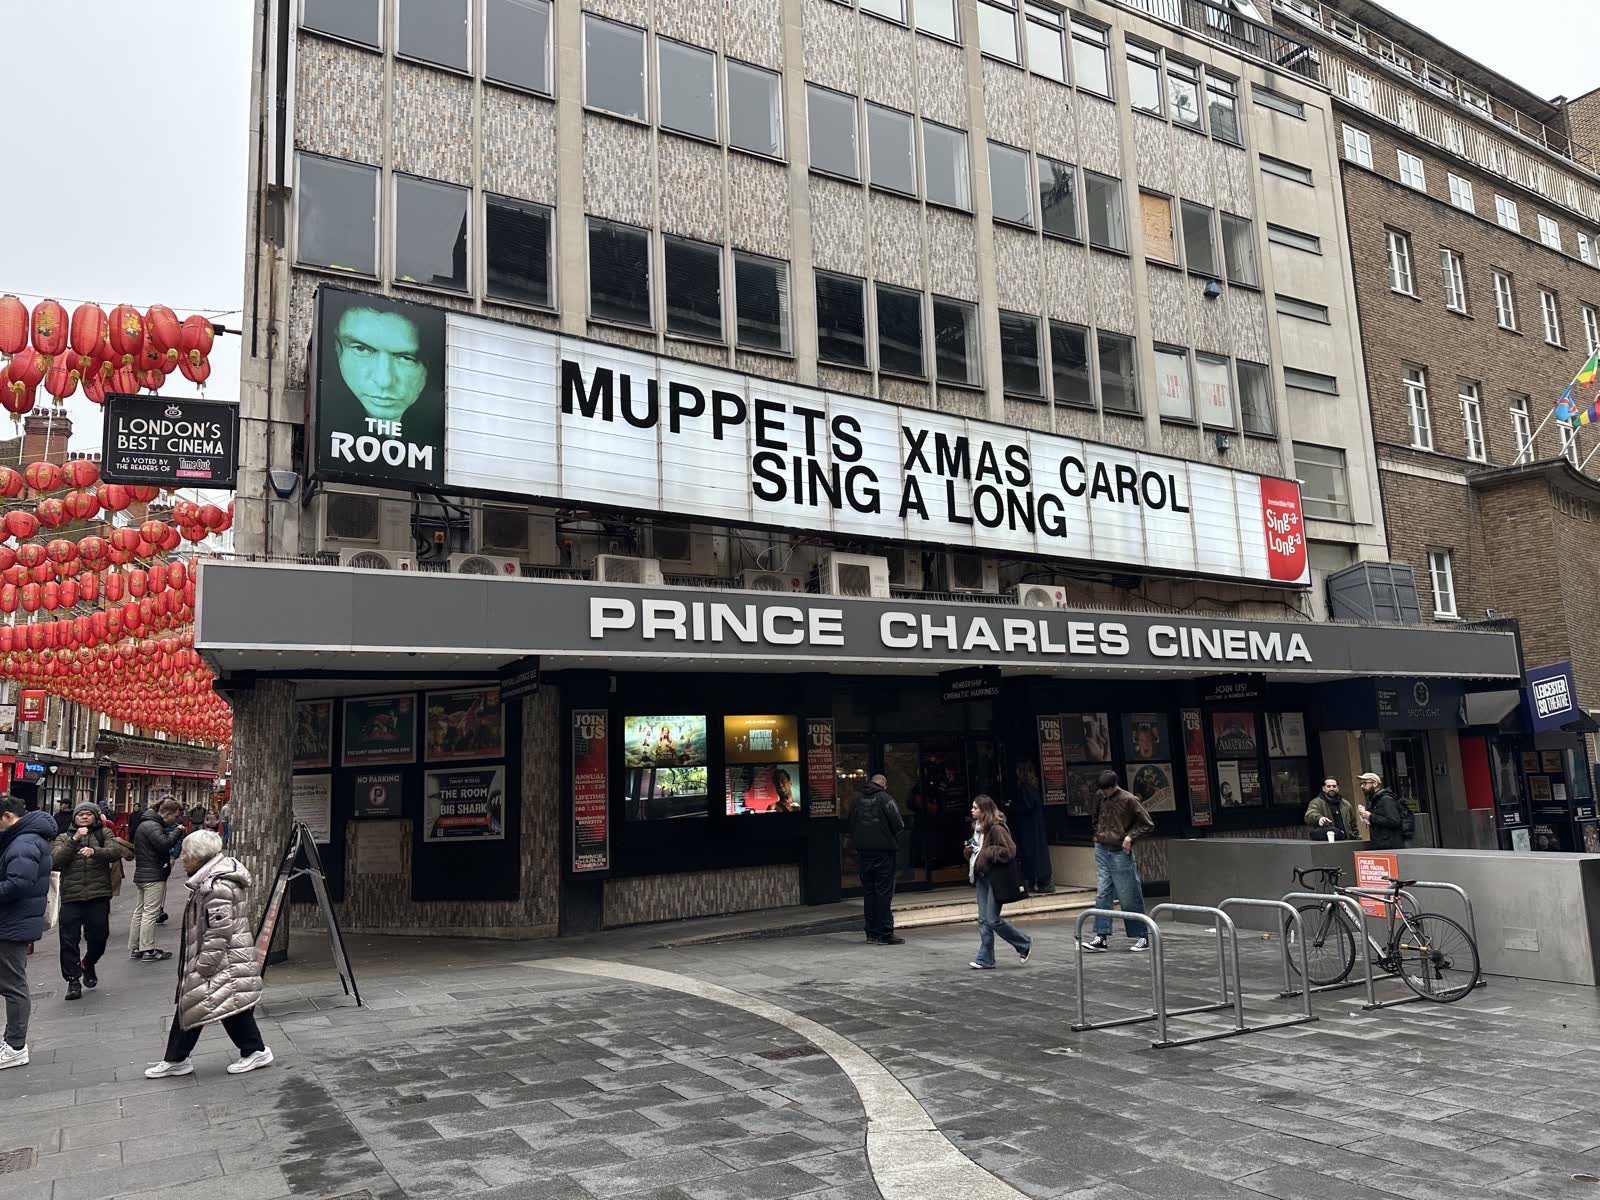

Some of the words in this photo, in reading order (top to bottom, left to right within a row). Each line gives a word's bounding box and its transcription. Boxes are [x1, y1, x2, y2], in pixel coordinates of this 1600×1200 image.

[118, 417, 221, 439] LONDON'S
[364, 417, 403, 437] THE
[561, 359, 863, 463] MUPPETS
[901, 425, 1031, 487] XMAS
[1059, 456, 1190, 513] CAROL
[118, 435, 159, 450] BEST
[167, 438, 224, 455] CINEMA
[330, 431, 433, 471] ROOM
[132, 457, 157, 465] VOTED
[752, 451, 881, 514] SING
[898, 474, 930, 520] A
[945, 479, 1067, 538] LONG
[1268, 530, 1302, 556] Long-a
[590, 597, 845, 646] PRINCE
[880, 611, 1130, 656] CHARLES
[1148, 625, 1313, 662] CINEMA
[971, 687, 999, 697] HAPPINESS
[1215, 685, 1233, 693] JOIN
[1535, 679, 1567, 699] LEICESTER
[1537, 699, 1549, 714] SQ
[1546, 693, 1570, 711] THEATRE
[575, 714, 605, 728] JOIN
[1183, 712, 1200, 720] JOIN
[808, 724, 832, 735] JOIN
[1039, 720, 1060, 731] JOIN
[1187, 719, 1200, 730] US
[581, 726, 606, 739] US
[1044, 728, 1061, 740] US
[812, 734, 833, 746] US
[357, 776, 368, 784] NO
[369, 775, 400, 783] PARKING
[440, 789, 457, 799] THE
[461, 788, 488, 799] ROOM
[440, 804, 455, 815] BIG
[457, 803, 488, 815] SHARK
